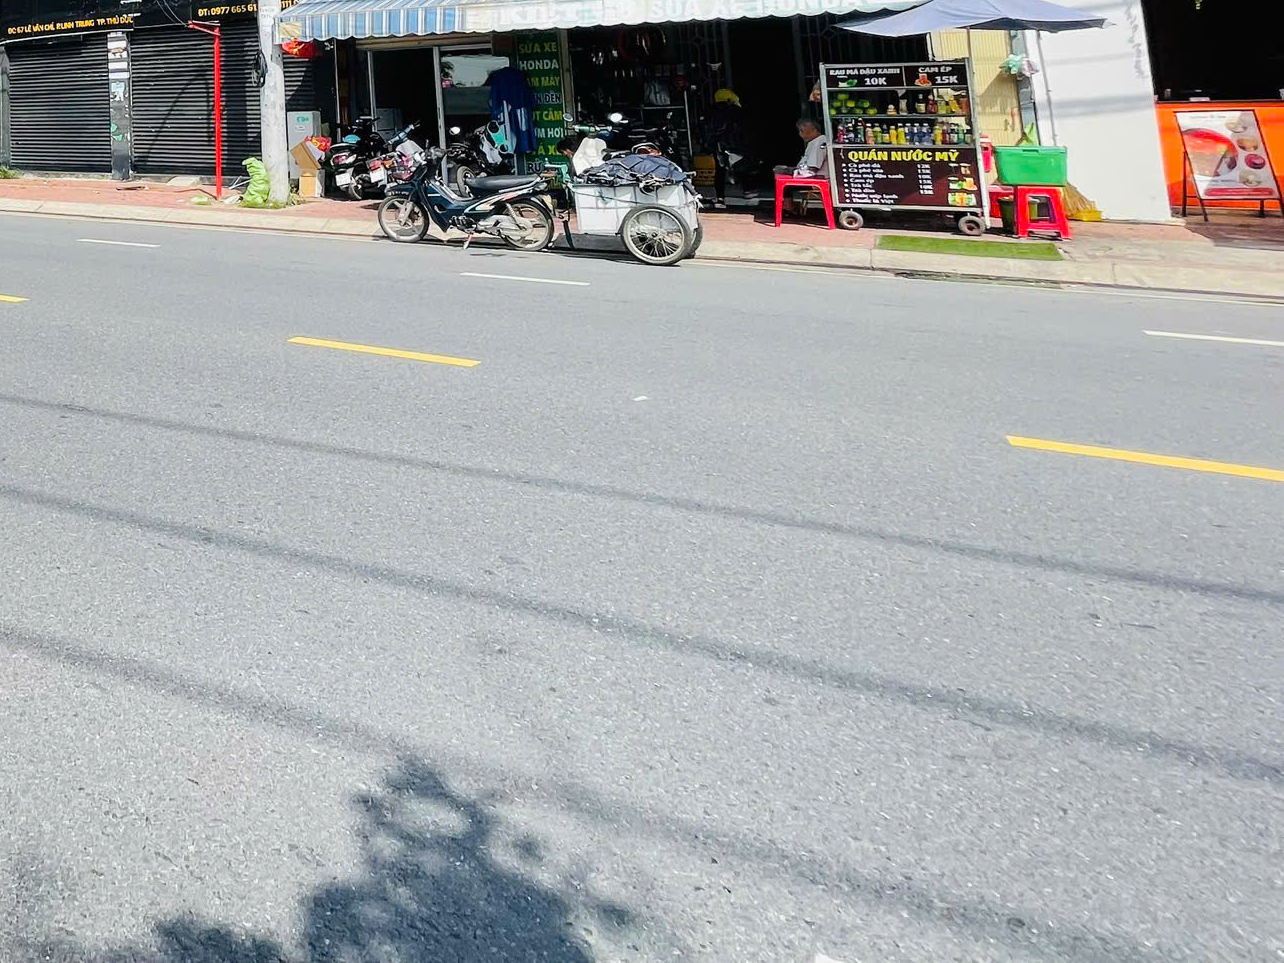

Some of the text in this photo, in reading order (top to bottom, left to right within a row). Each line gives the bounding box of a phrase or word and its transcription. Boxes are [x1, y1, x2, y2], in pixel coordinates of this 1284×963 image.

[231, 5, 247, 13] 665
[75, 19, 94, 27] TRUNG
[544, 42, 557, 52] XE
[519, 59, 559, 70] HONDA
[864, 77, 887, 85] 10K
[848, 149, 959, 162] QUÁN NƯỚC MỸ
